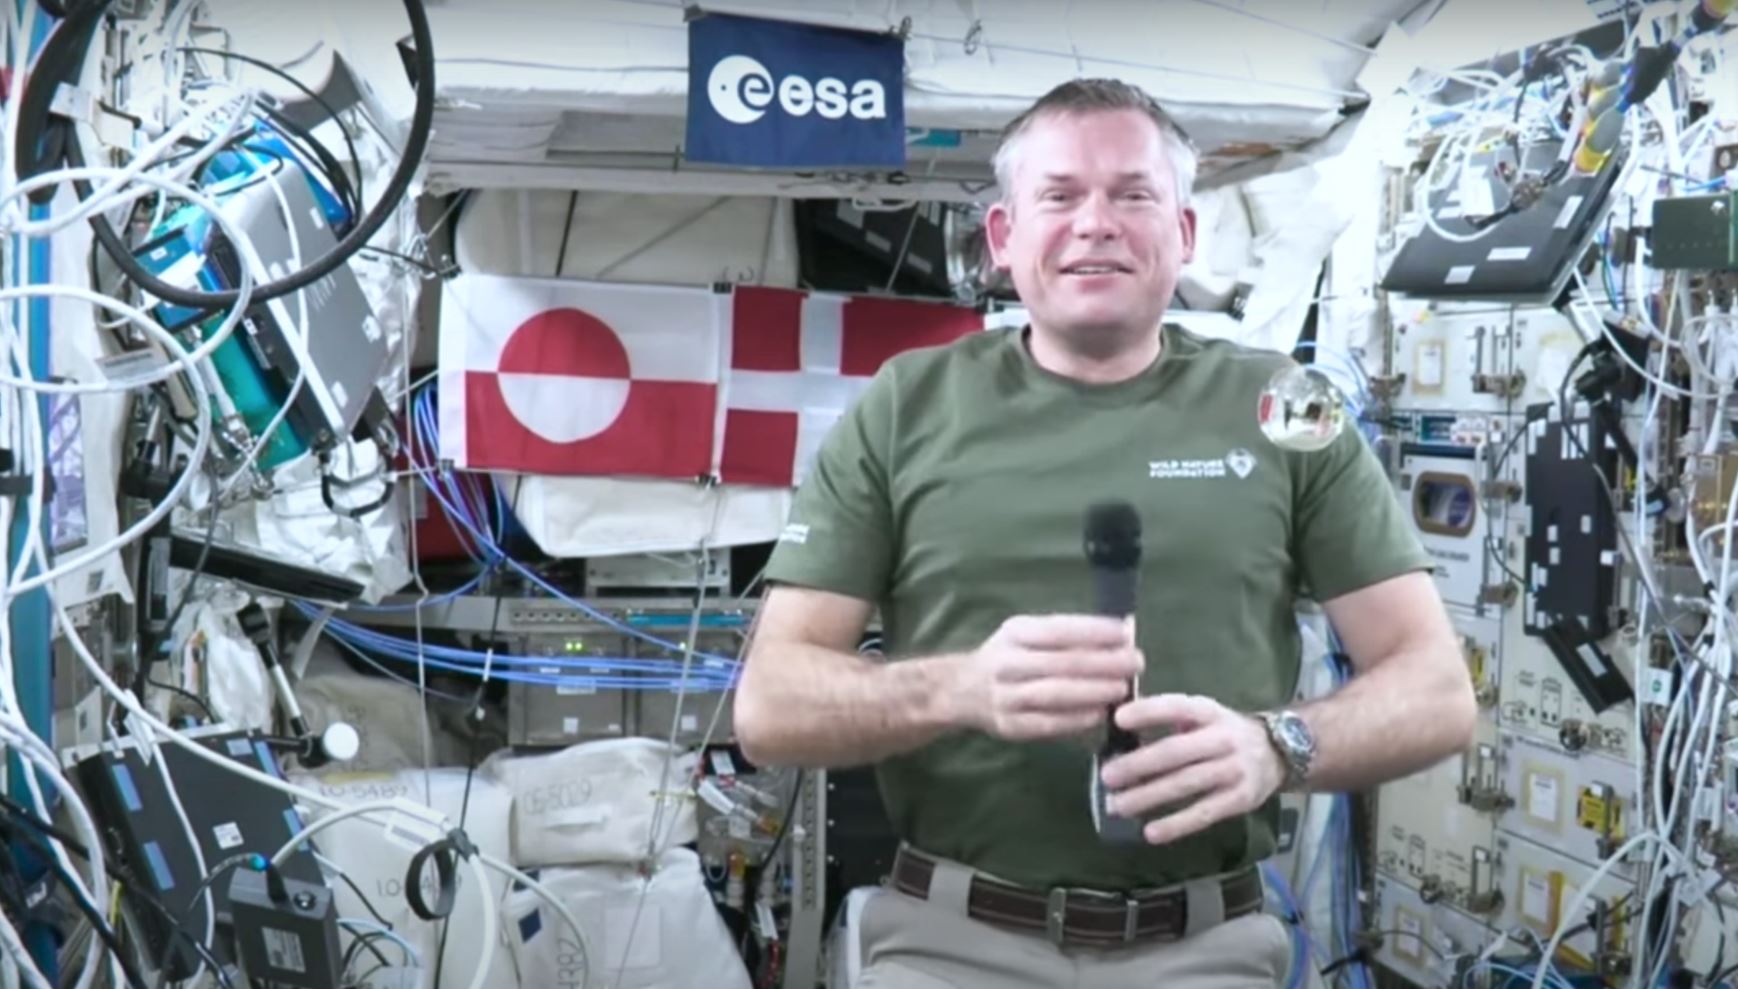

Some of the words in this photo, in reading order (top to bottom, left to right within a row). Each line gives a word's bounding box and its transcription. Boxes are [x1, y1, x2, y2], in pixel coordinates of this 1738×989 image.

[778, 74, 887, 120] esa
[1148, 460, 1180, 469] WILD
[1181, 459, 1224, 469] NATURE
[1149, 468, 1227, 478] FOUNDATION
